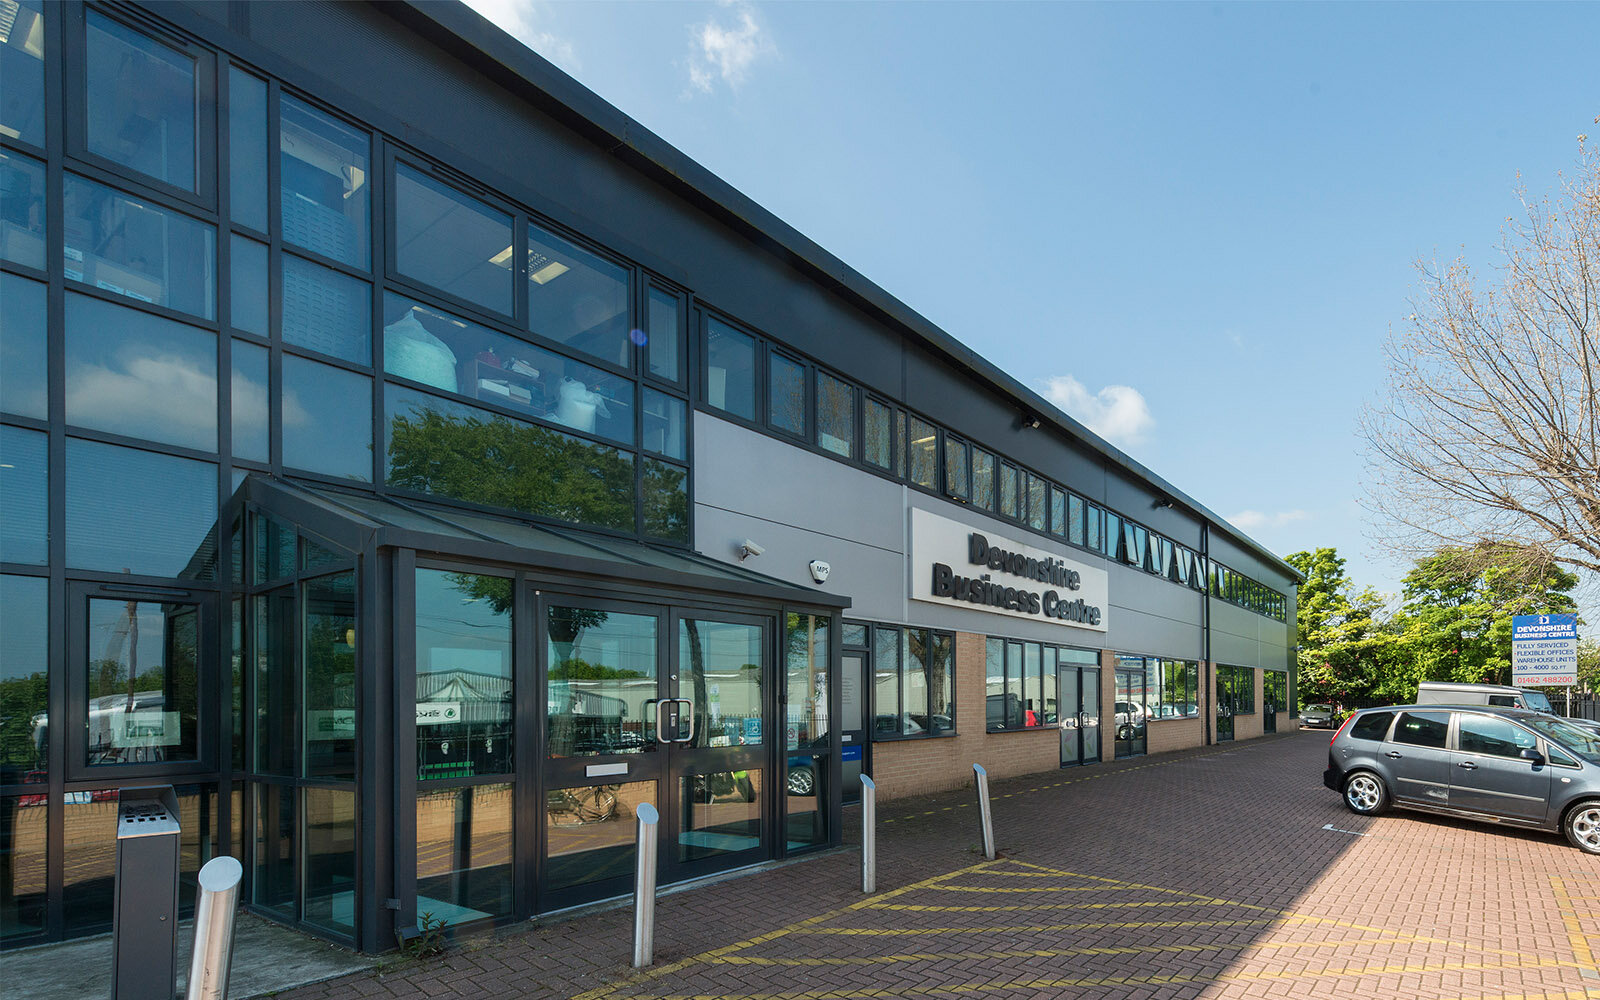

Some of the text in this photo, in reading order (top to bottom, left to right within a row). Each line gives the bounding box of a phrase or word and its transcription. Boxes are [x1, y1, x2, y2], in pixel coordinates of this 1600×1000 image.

[970, 532, 1081, 591] Devonshire
[933, 562, 1102, 626] Business Centre
[1517, 624, 1572, 633] DEVONSHIRE
